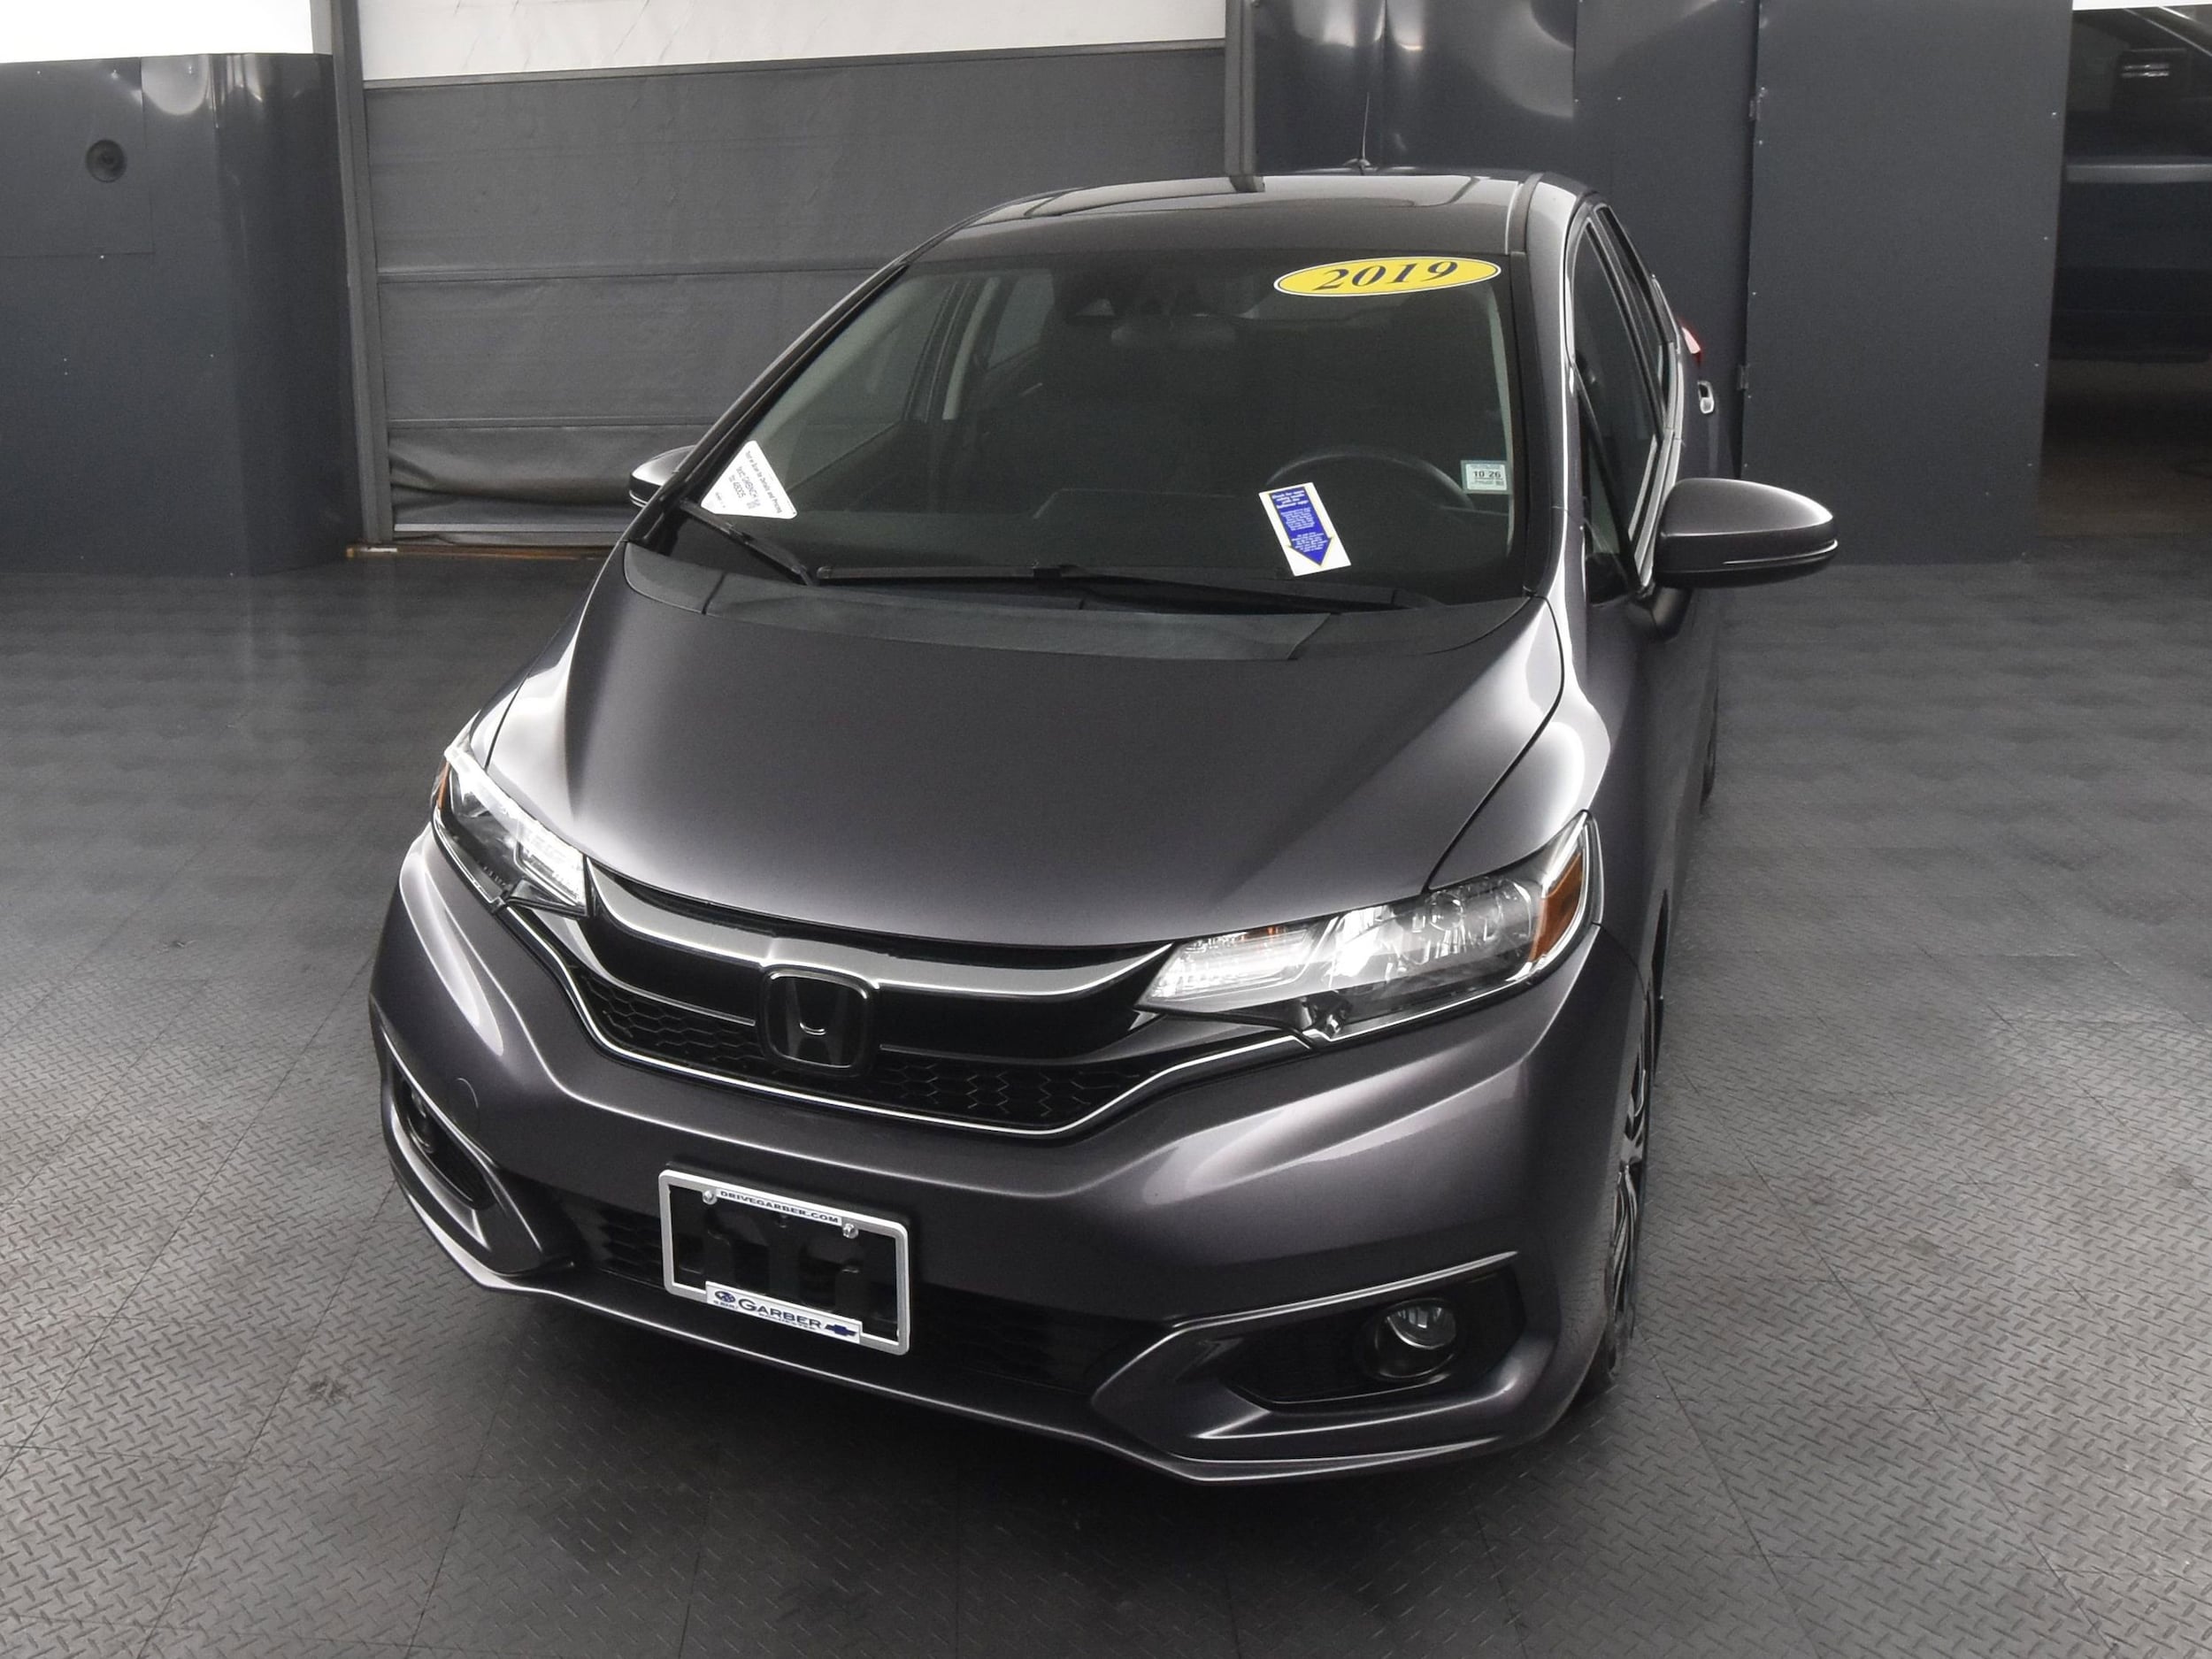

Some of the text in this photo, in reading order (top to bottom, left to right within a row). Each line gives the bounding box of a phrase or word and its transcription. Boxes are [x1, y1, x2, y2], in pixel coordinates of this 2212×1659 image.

[1312, 261, 1458, 291] 2019
[720, 1190, 839, 1223] DRIVEGARBER.COM
[738, 1298, 822, 1329] GARBER
